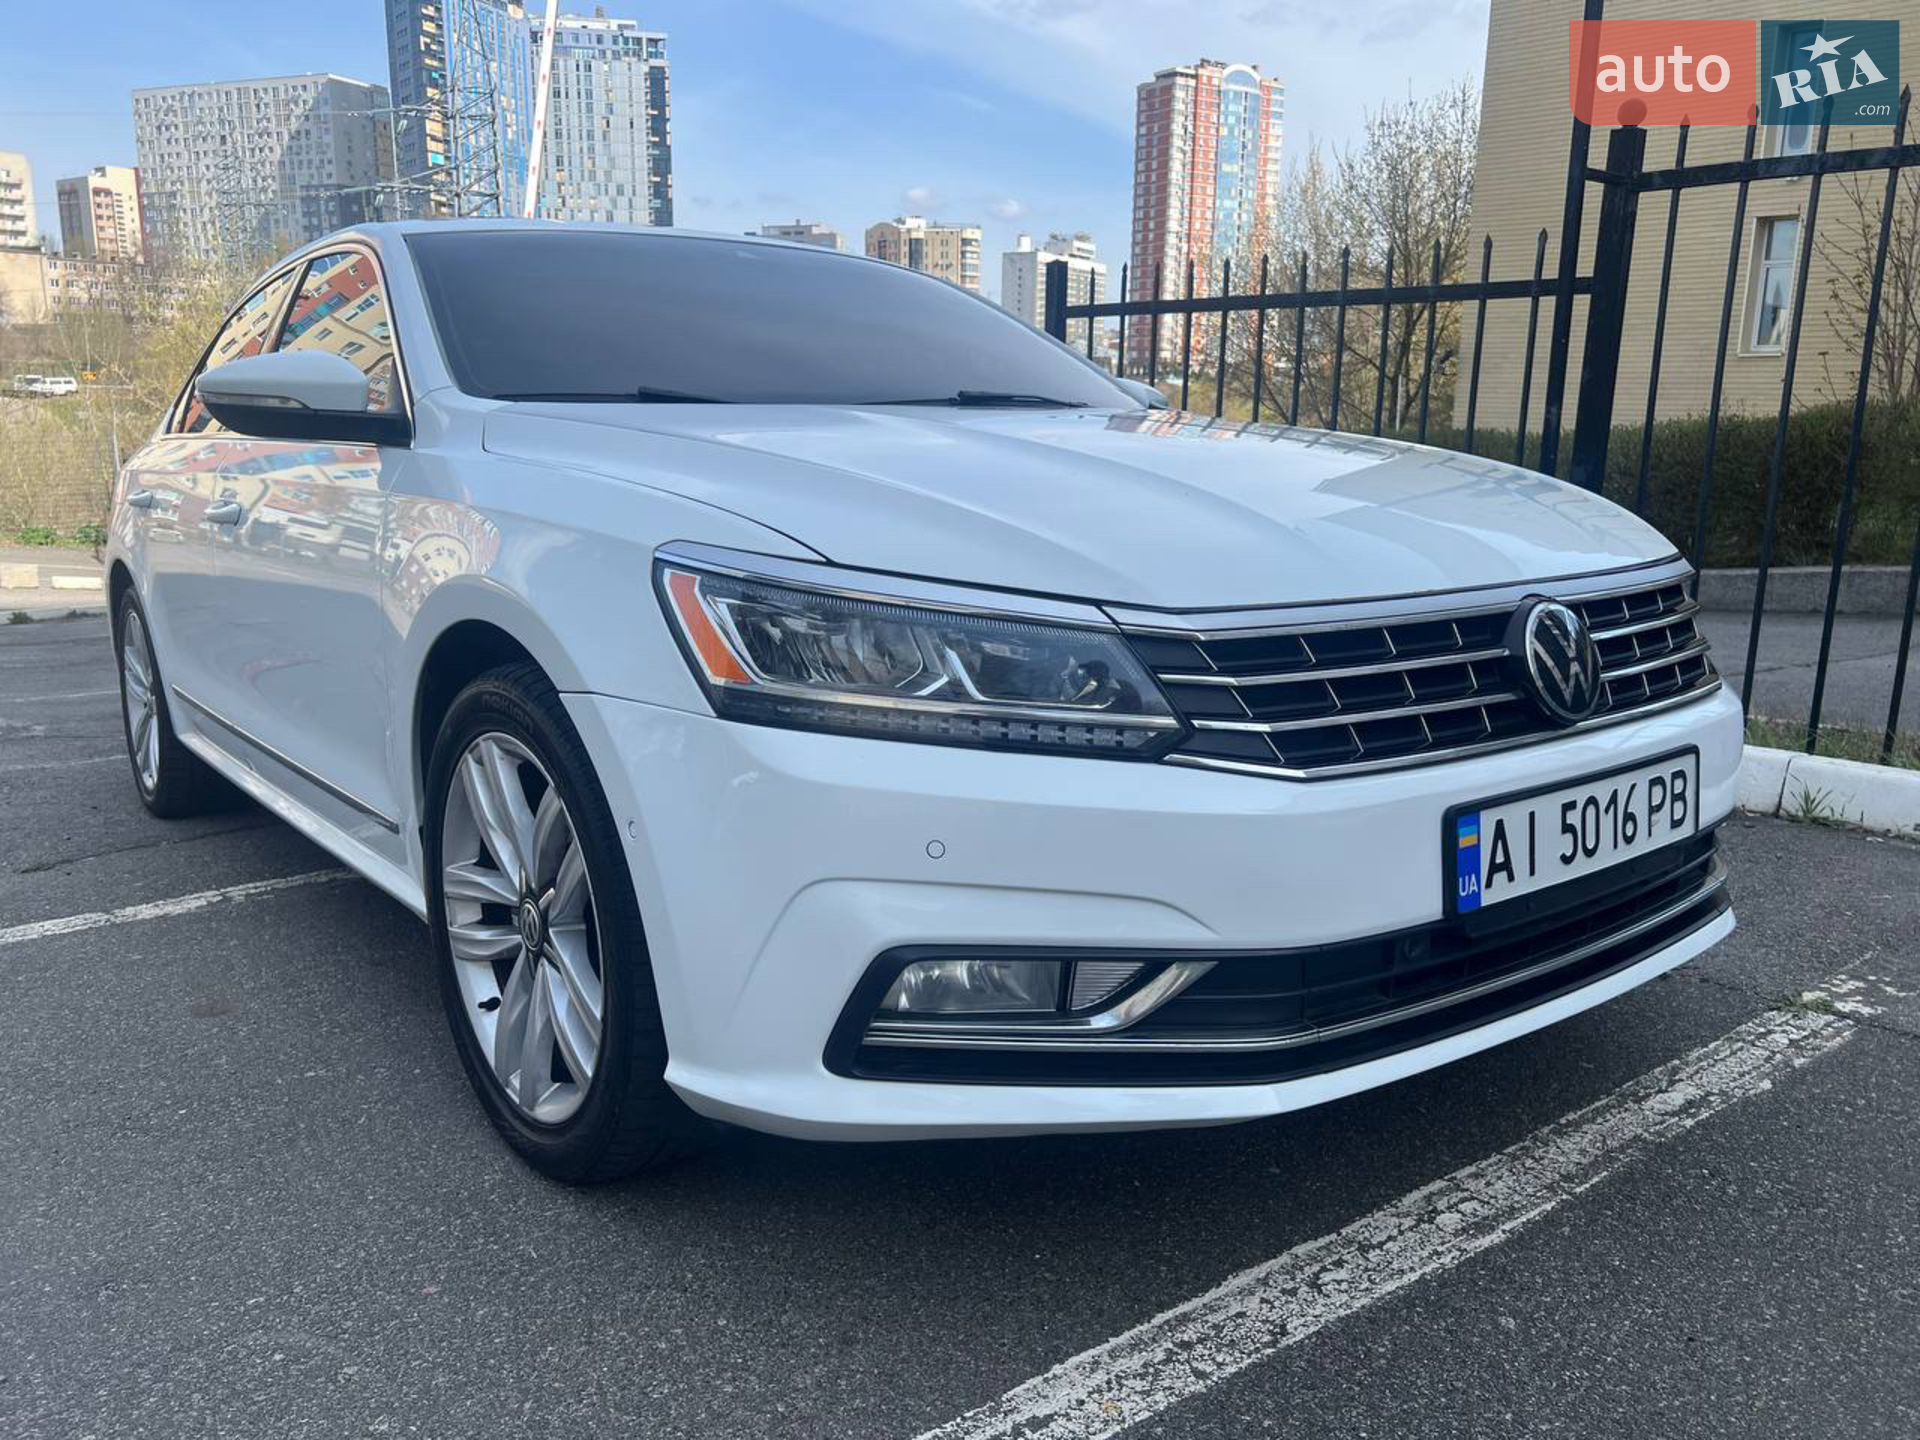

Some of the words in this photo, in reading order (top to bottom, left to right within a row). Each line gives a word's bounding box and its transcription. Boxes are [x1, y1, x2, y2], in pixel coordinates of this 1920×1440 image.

[1484, 810, 1536, 889] AI
[1559, 782, 1638, 865] 5016
[1648, 768, 1688, 838] PB
[1458, 873, 1478, 897] UA
